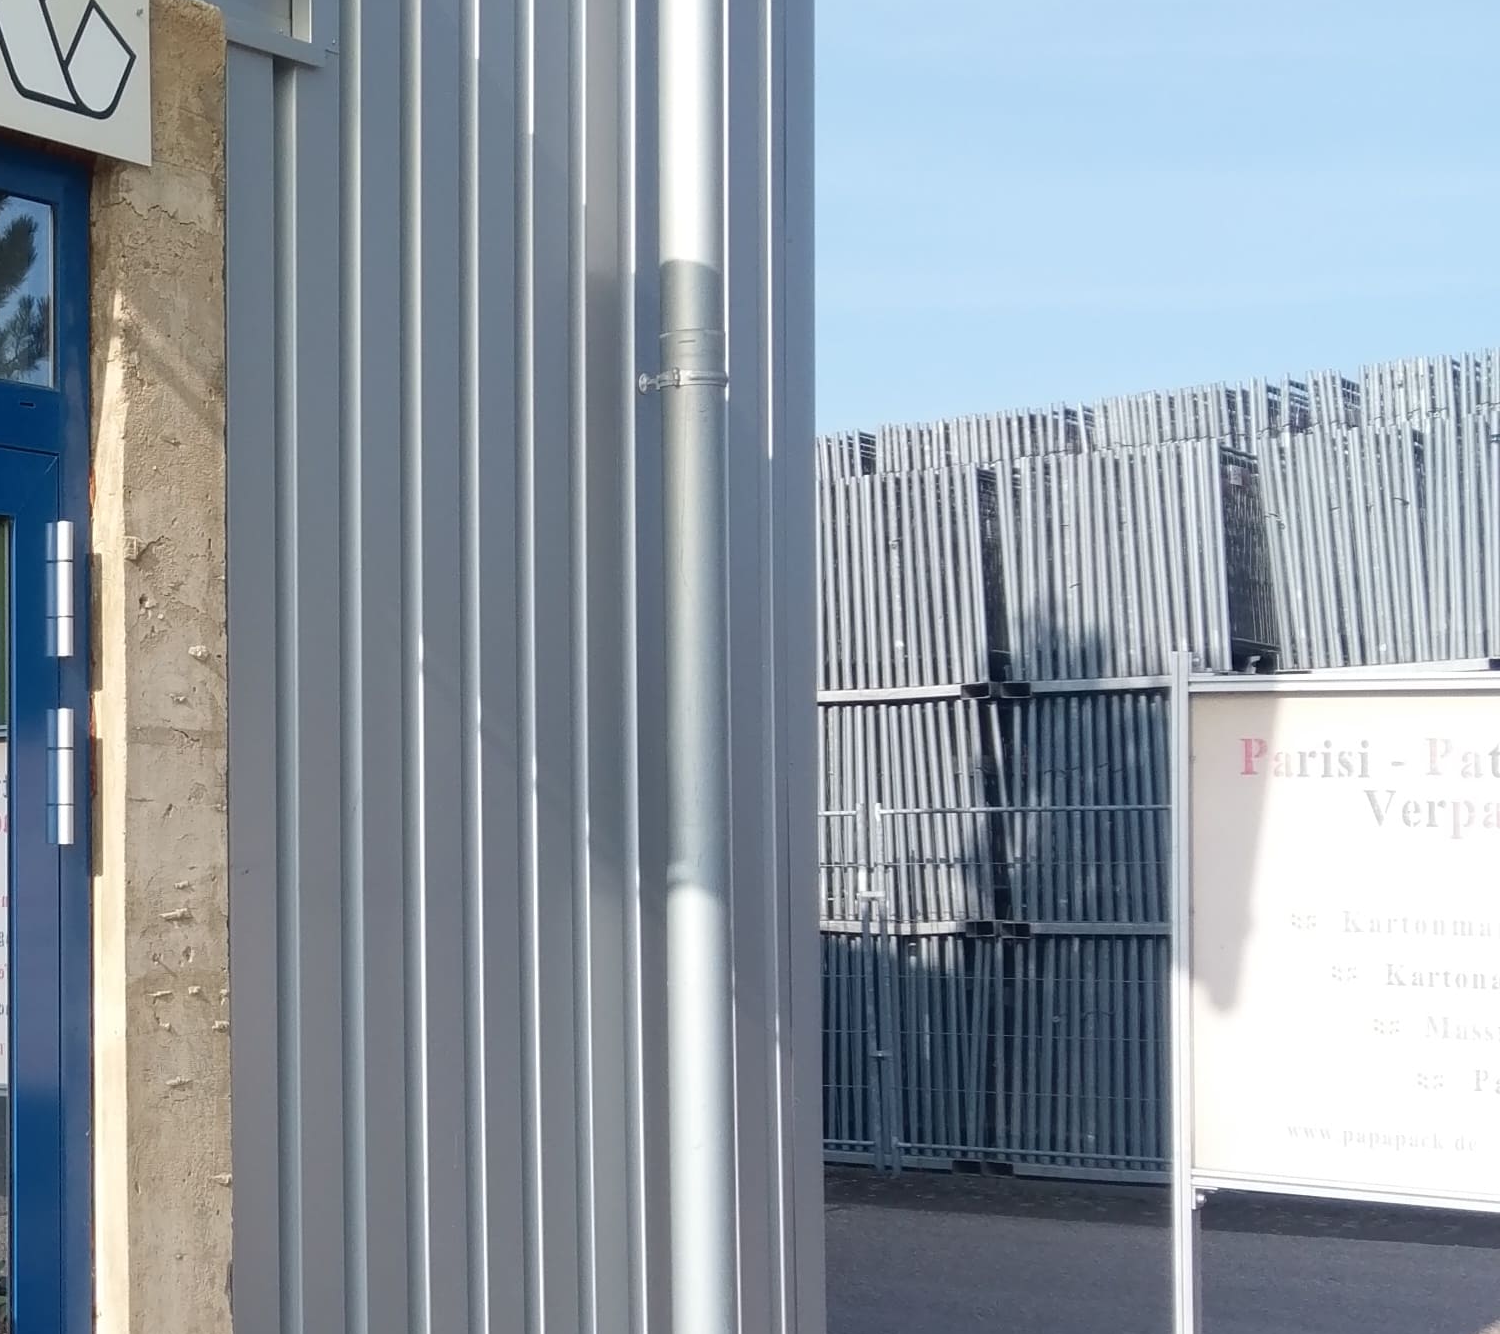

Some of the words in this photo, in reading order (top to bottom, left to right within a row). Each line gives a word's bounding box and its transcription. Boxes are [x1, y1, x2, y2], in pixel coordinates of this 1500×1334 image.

[1238, 738, 1370, 778] Parisi
[1342, 910, 1500, 938] Kartonma
[1425, 1015, 1500, 1043] Mass
